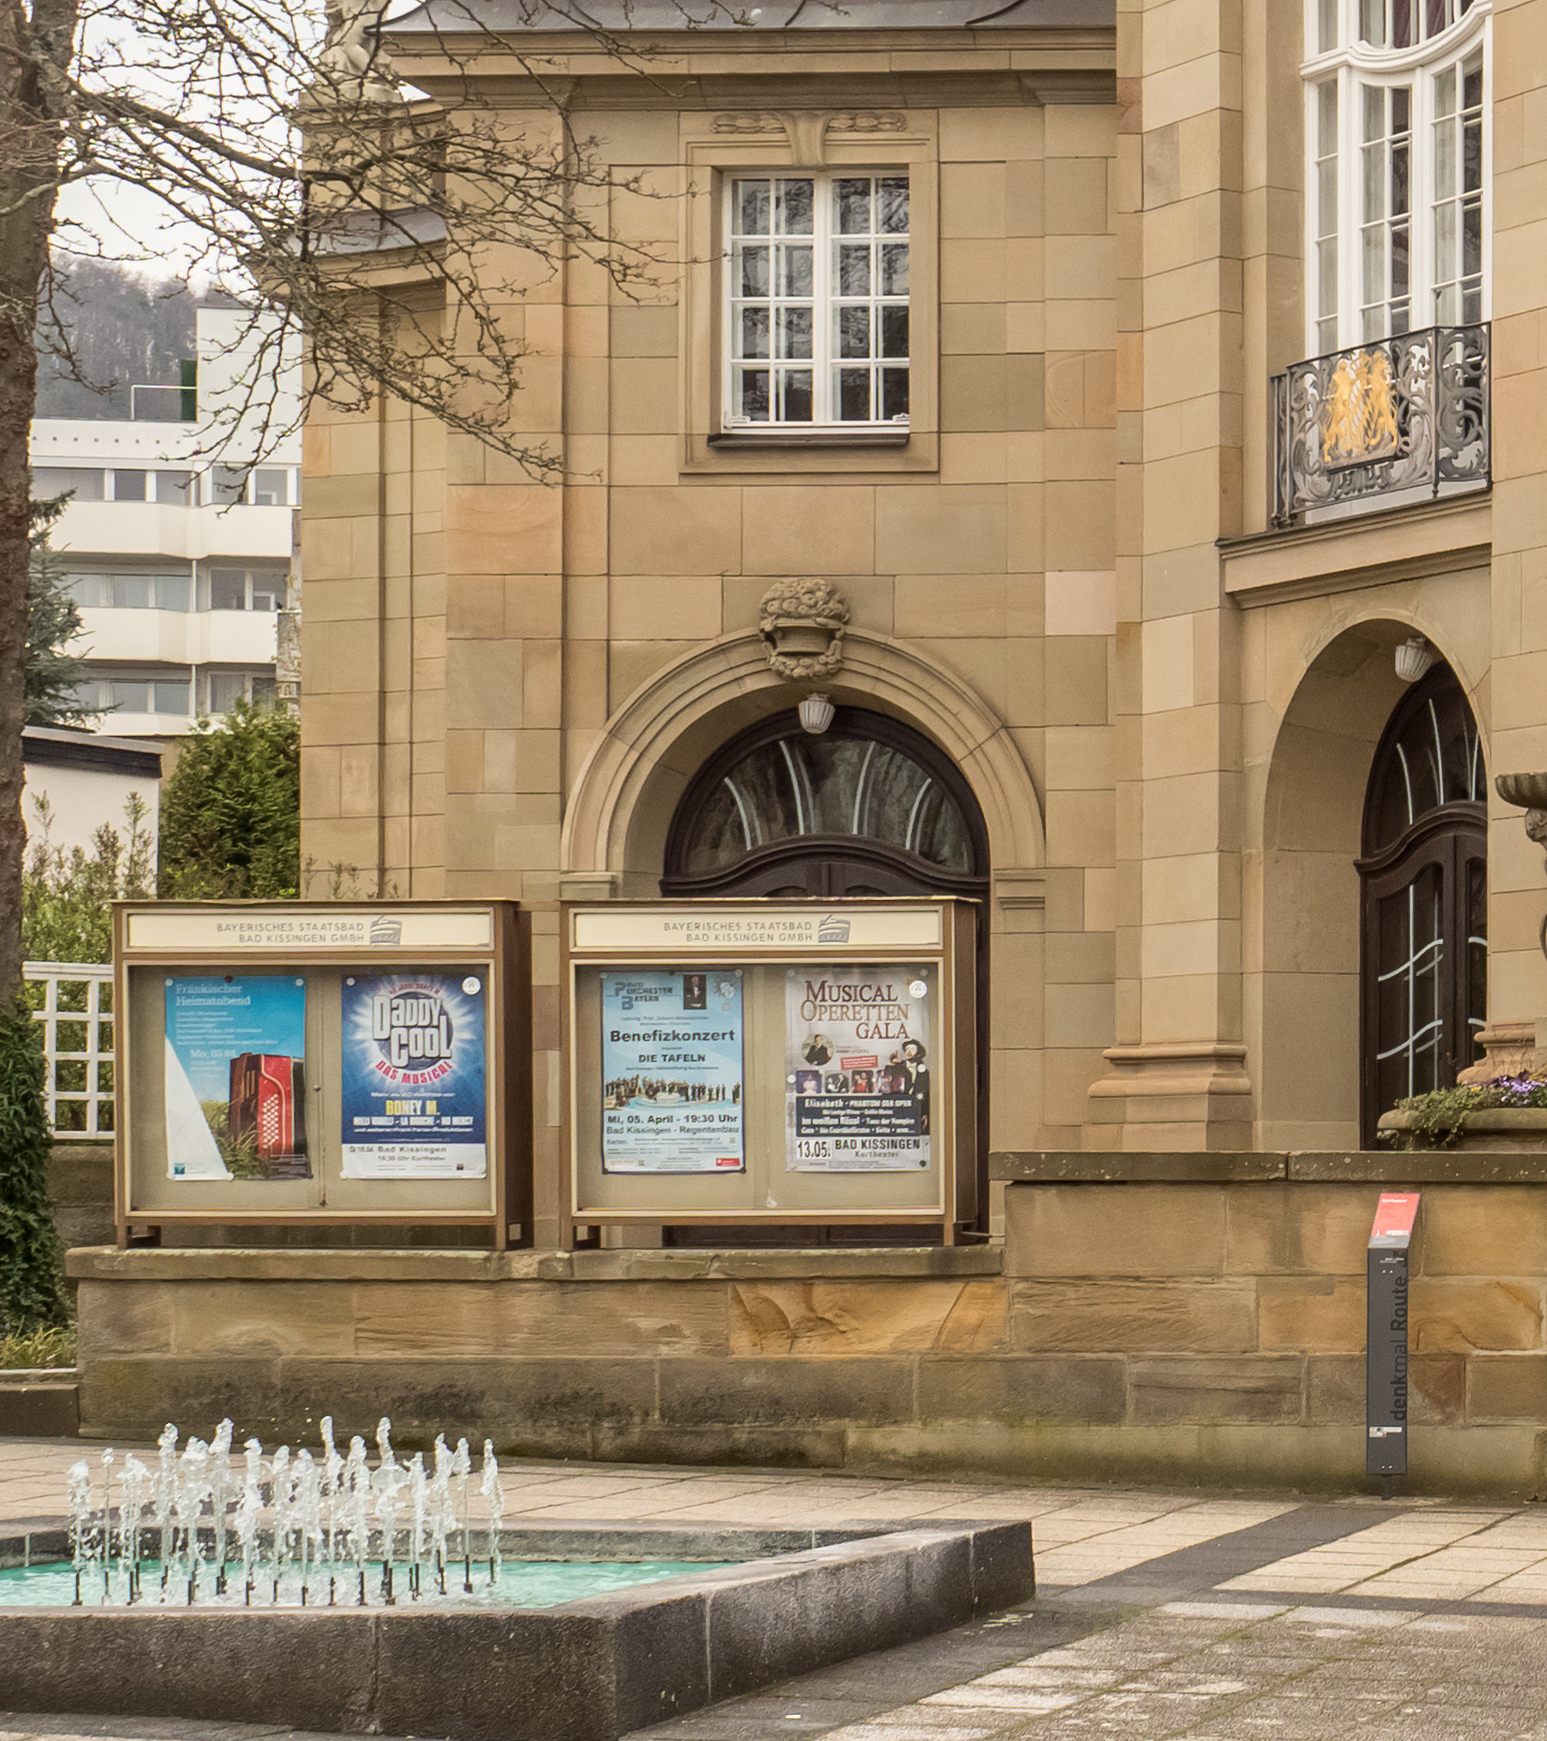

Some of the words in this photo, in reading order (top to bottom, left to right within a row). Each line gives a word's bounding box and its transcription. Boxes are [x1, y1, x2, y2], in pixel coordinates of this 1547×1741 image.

[216, 923, 294, 932] BAYERISCHES
[299, 923, 364, 932] STAATSBAD
[664, 922, 741, 931] BAYERISCHES
[747, 922, 812, 931] STAATSBAD
[239, 934, 262, 943] BAD
[266, 934, 326, 943] KISSINGEN
[686, 933, 709, 942] BAD
[714, 933, 774, 942] KISSINGEN
[856, 1023, 910, 1039] GALA
[610, 1030, 735, 1043] Benefizkonzert
[638, 1054, 657, 1063] DIE
[662, 1053, 706, 1063] TAFELN
[375, 1060, 399, 1081] DAS
[401, 1061, 454, 1085] MUSICAL
[386, 1100, 422, 1115] BONEY
[627, 1115, 644, 1123] 05.
[647, 1115, 674, 1125] April
[684, 1114, 715, 1123] 19:30
[718, 1114, 738, 1123] Uhr
[606, 1127, 624, 1135] Bad
[626, 1127, 671, 1135] Kissingen
[680, 1126, 739, 1135] Regentenbau
[835, 1139, 857, 1149] BAD
[861, 1139, 920, 1149] KISSINGEN
[378, 1145, 396, 1153] Bad
[399, 1145, 447, 1154] Kissingen
[1390, 1275, 1408, 1332] Route
[1390, 1339, 1408, 1421] denkmal
